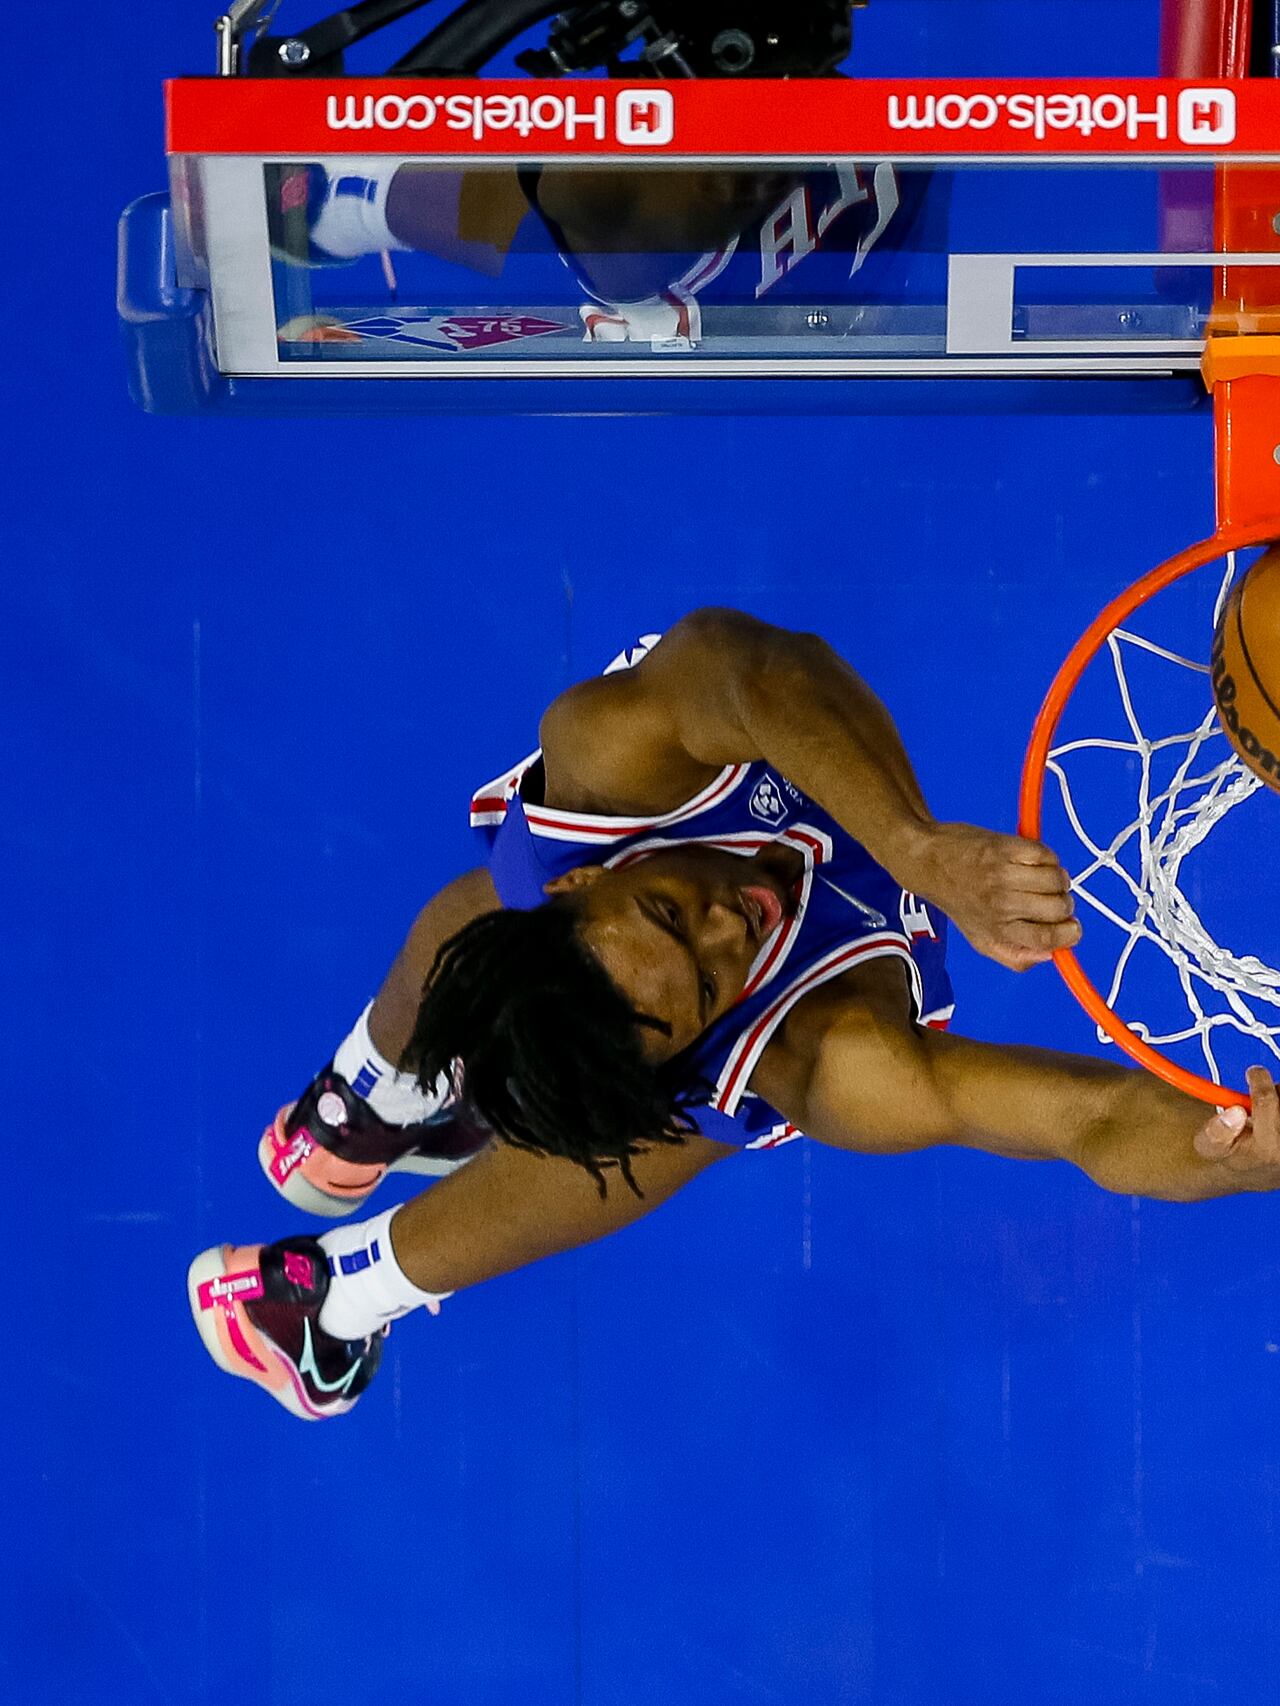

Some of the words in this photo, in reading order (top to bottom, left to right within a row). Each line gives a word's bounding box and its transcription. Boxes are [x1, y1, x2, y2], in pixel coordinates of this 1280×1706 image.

[327, 95, 605, 139] Hotels.com
[889, 95, 1167, 139] Hotels.com
[478, 321, 522, 333] 75
